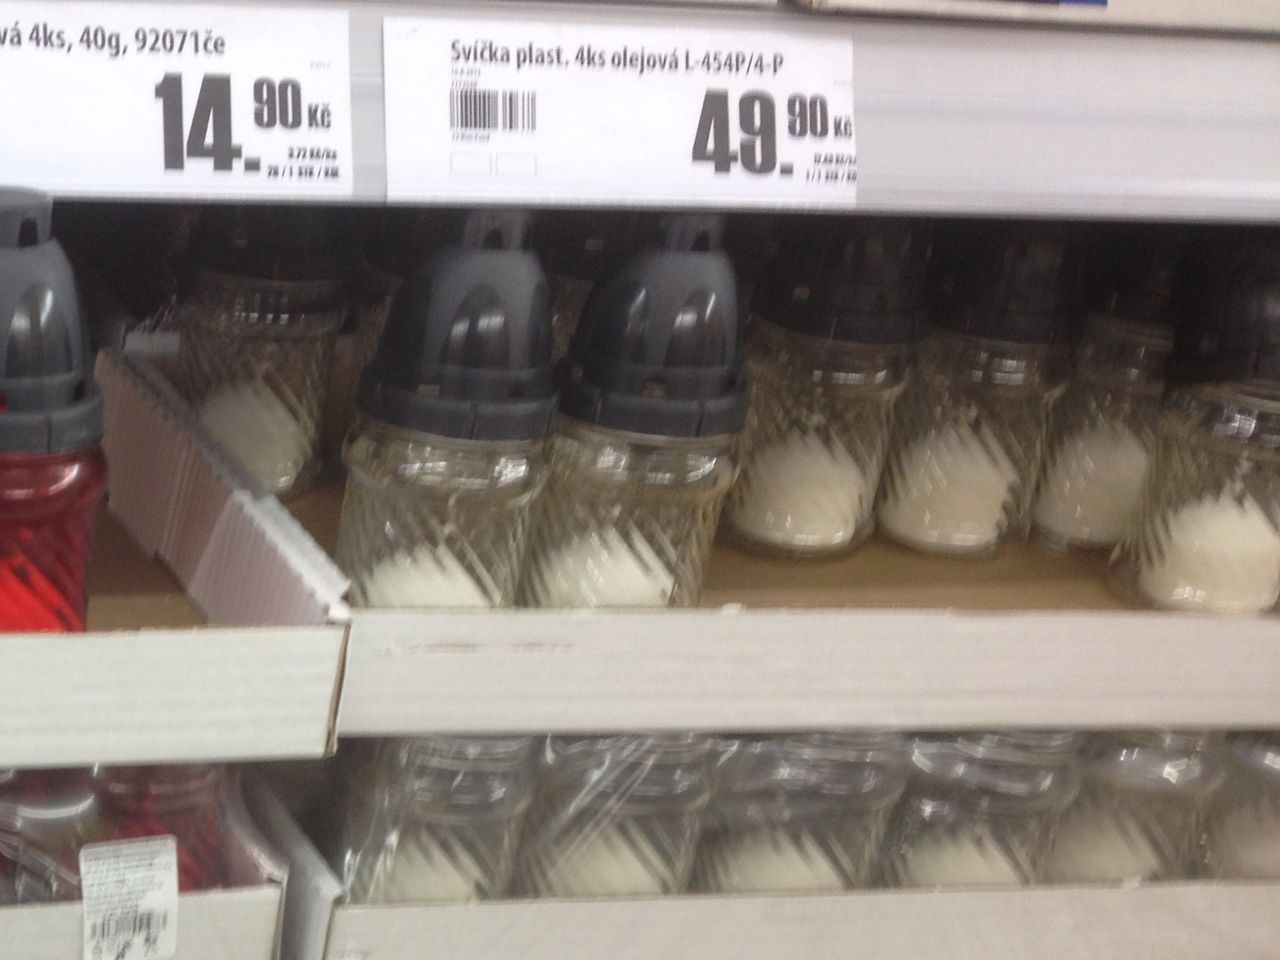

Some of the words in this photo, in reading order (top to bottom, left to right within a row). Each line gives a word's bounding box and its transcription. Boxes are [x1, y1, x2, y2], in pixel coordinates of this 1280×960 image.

[29, 23, 73, 52] 4ks,
[79, 26, 127, 57] 40g,
[134, 28, 226, 55] 92071če
[451, 38, 510, 63] Svíčka
[516, 42, 568, 69] plast.
[575, 44, 606, 68] 4ks
[611, 46, 679, 75] olejová
[253, 77, 302, 129] 90
[308, 103, 331, 129] Kč
[788, 92, 829, 137] 90
